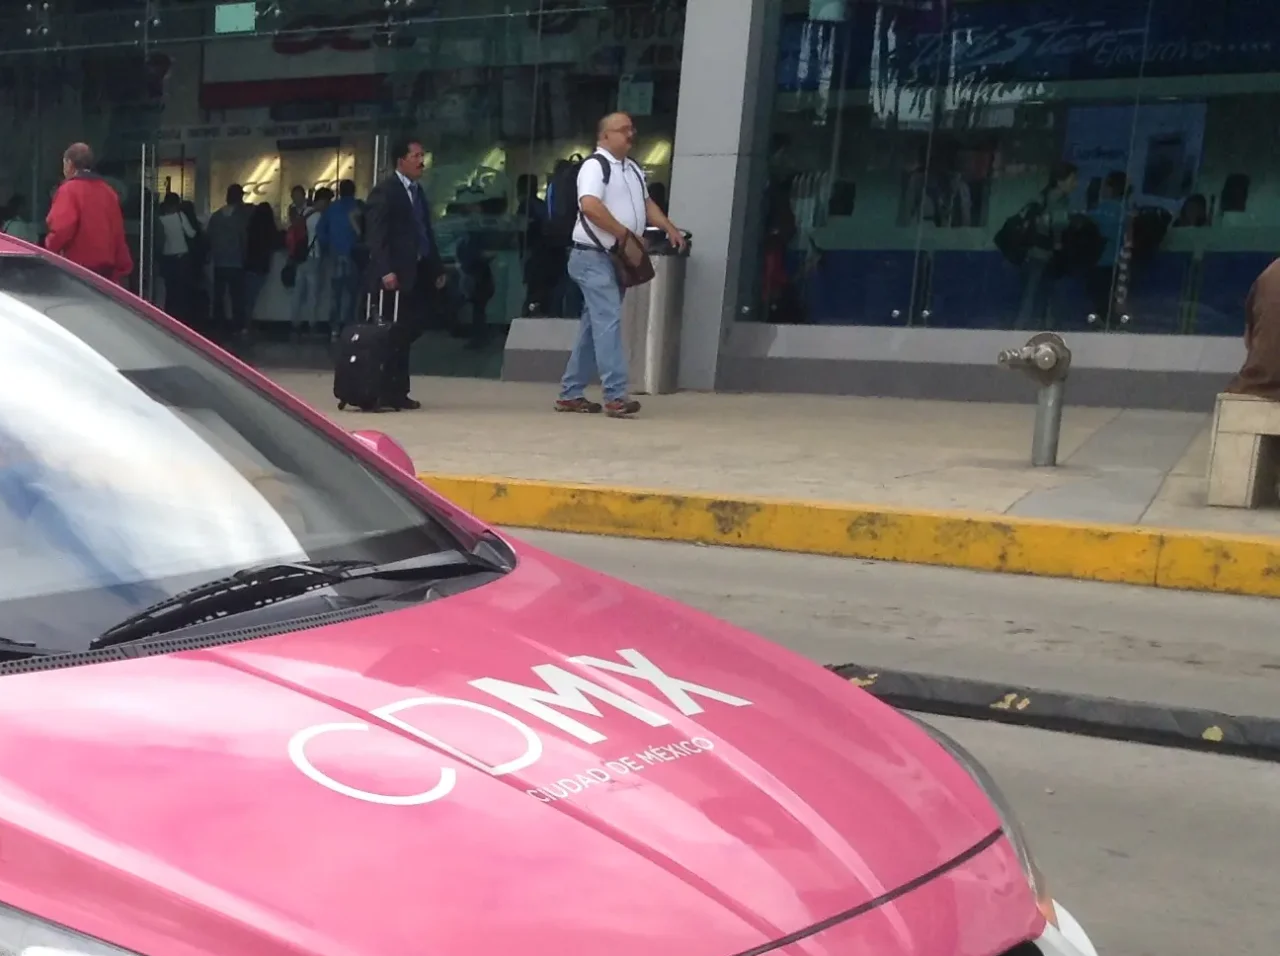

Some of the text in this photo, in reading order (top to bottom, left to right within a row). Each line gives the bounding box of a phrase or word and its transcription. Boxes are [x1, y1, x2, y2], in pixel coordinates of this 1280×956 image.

[288, 648, 753, 805] CDMX
[526, 737, 715, 803] CIUDAD DE MÉXICO
